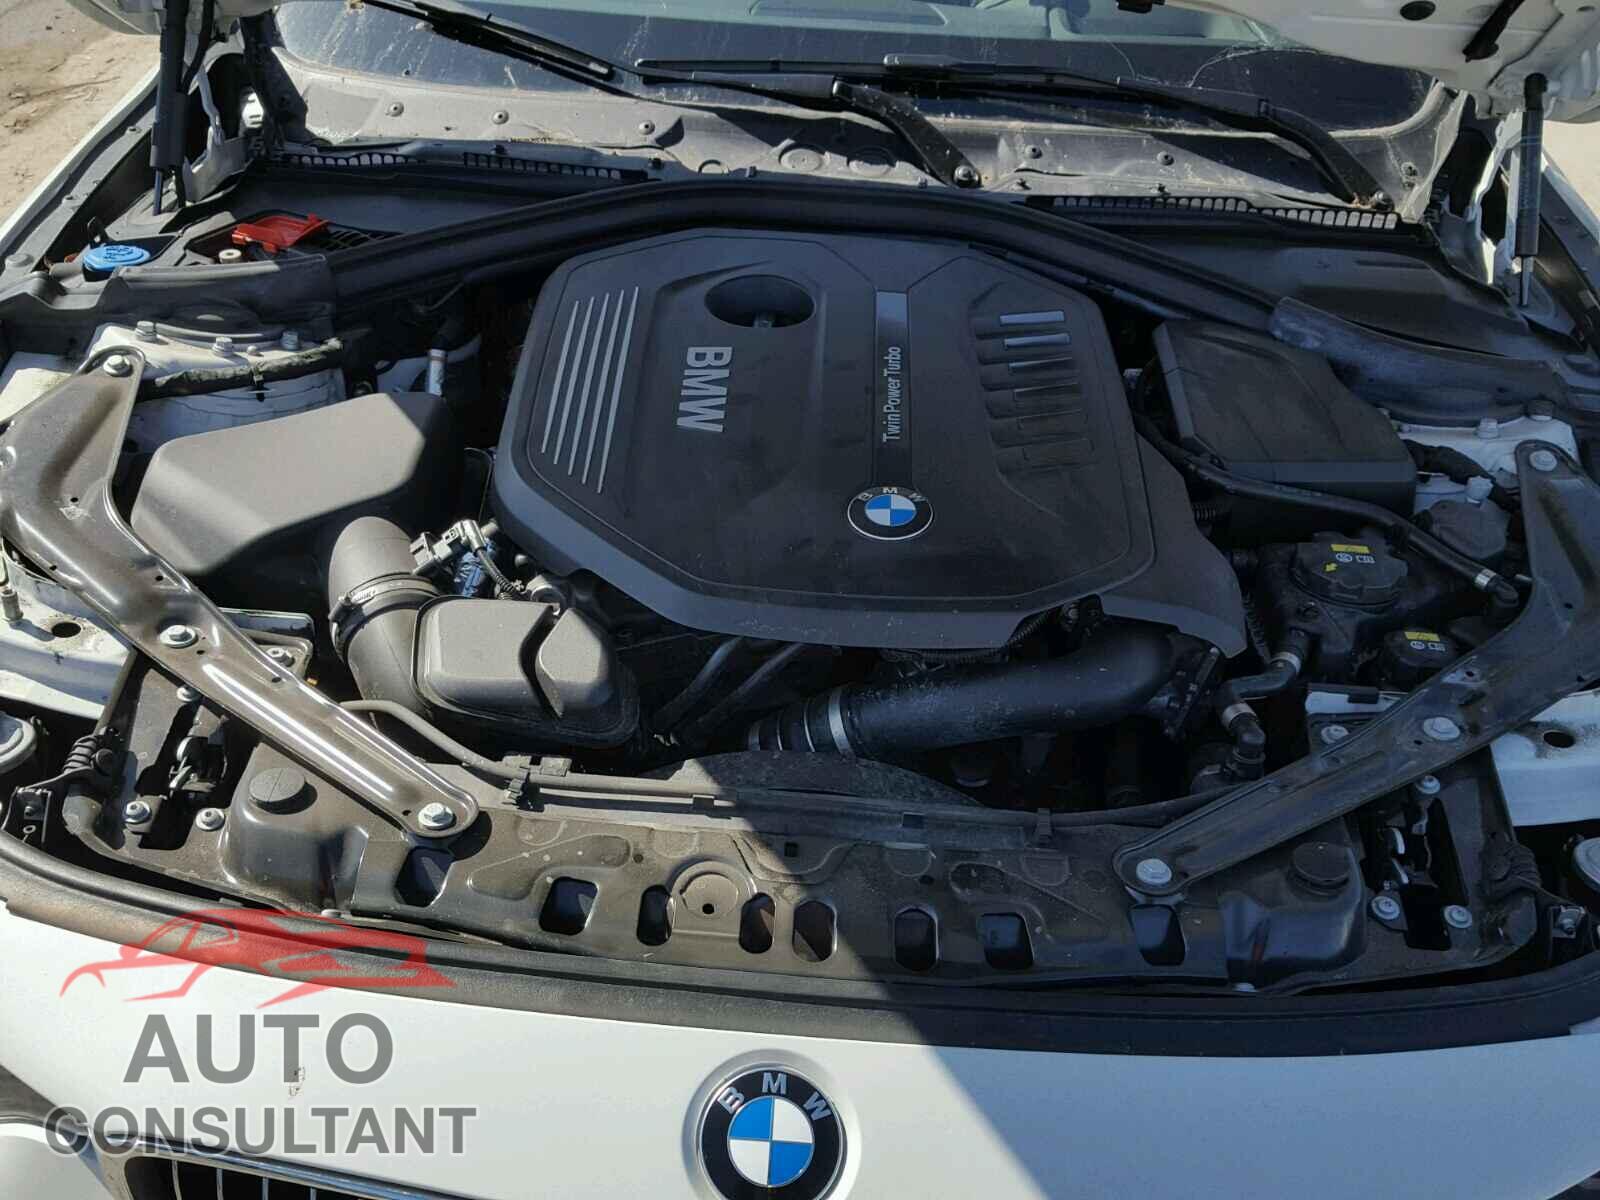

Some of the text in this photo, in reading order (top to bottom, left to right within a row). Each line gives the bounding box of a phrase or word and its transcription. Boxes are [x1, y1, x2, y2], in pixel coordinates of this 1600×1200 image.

[883, 346, 901, 376] Turbo
[677, 347, 732, 432] BMW
[717, 1072, 832, 1121] BMW
